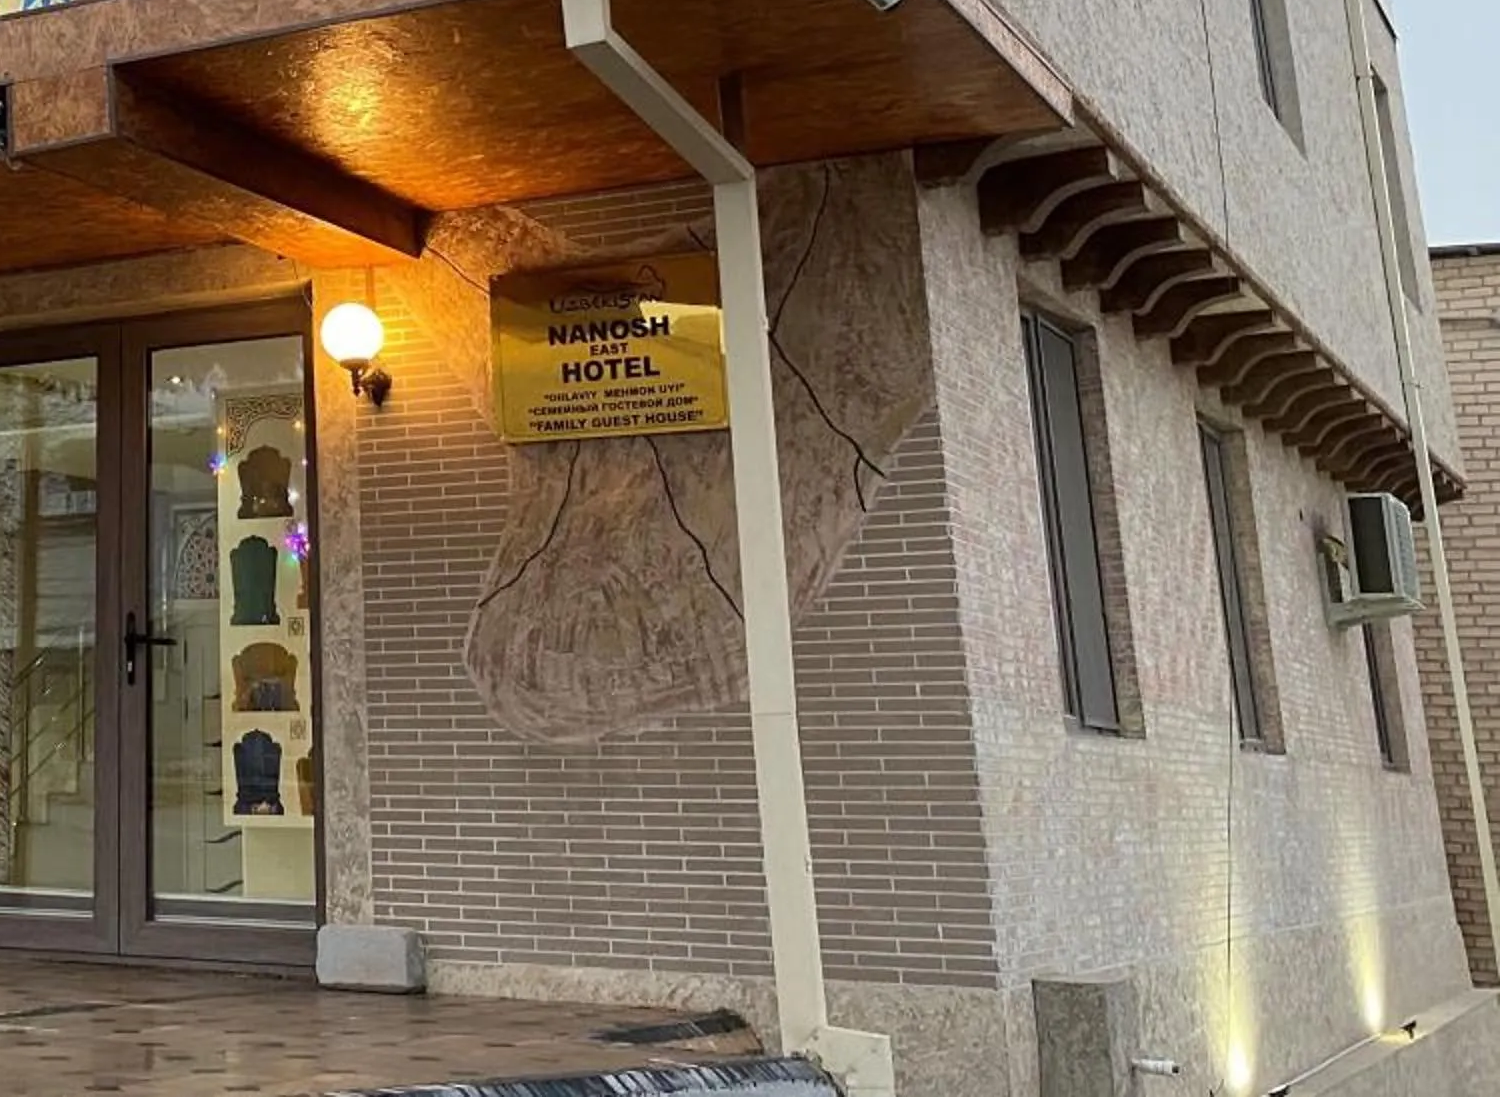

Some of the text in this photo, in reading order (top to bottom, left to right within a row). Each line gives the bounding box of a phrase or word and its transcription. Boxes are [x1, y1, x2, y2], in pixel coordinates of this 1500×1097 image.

[548, 315, 670, 345] NANOSH
[590, 342, 628, 356] EAST
[562, 356, 660, 383] HOTEL
[592, 414, 641, 428] GUEST
